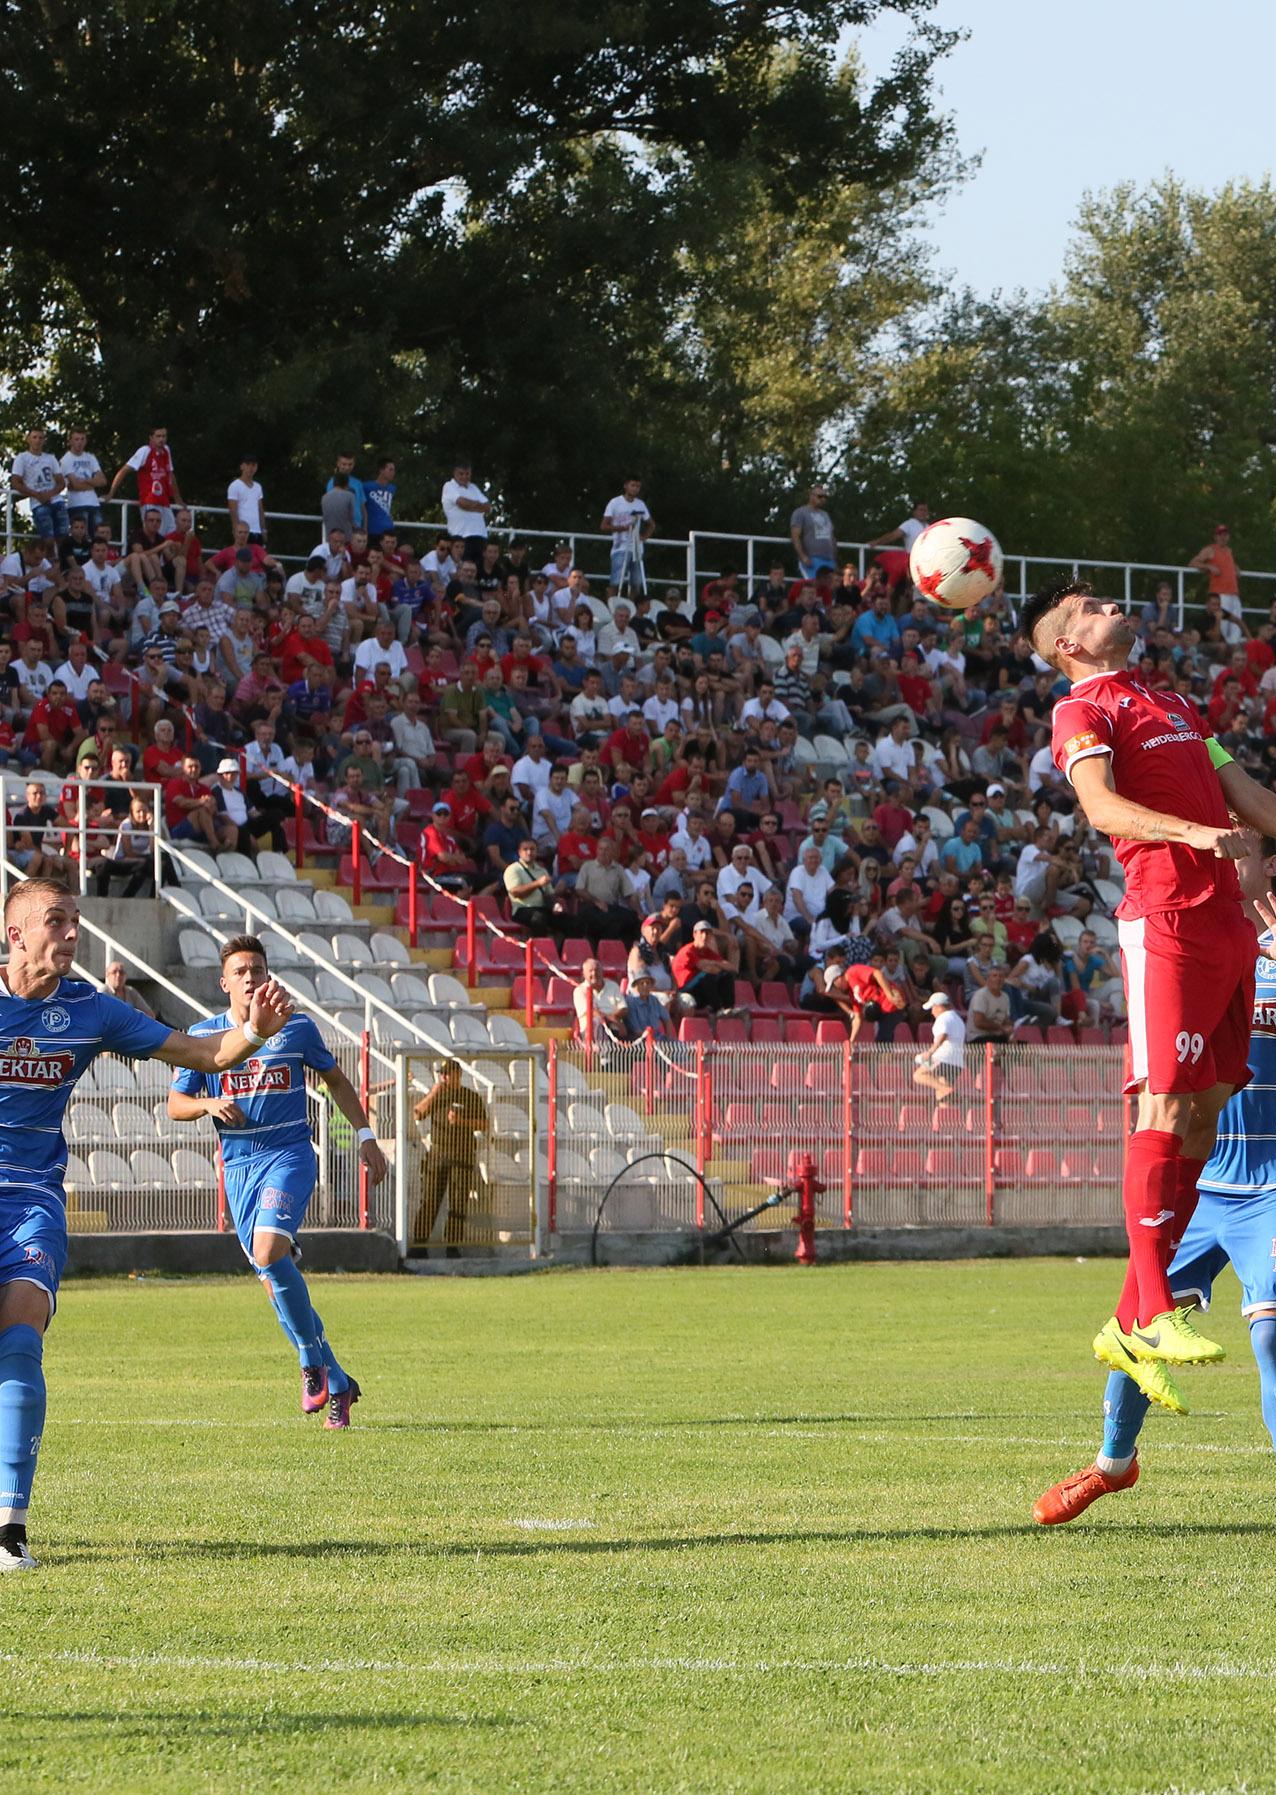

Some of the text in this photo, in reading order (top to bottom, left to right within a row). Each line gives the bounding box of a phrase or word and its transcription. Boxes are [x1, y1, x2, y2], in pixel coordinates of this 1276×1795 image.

[1175, 1030, 1204, 1065] 99
[0, 1059, 63, 1080] EKTAR
[226, 1071, 285, 1090] NEKTAR
